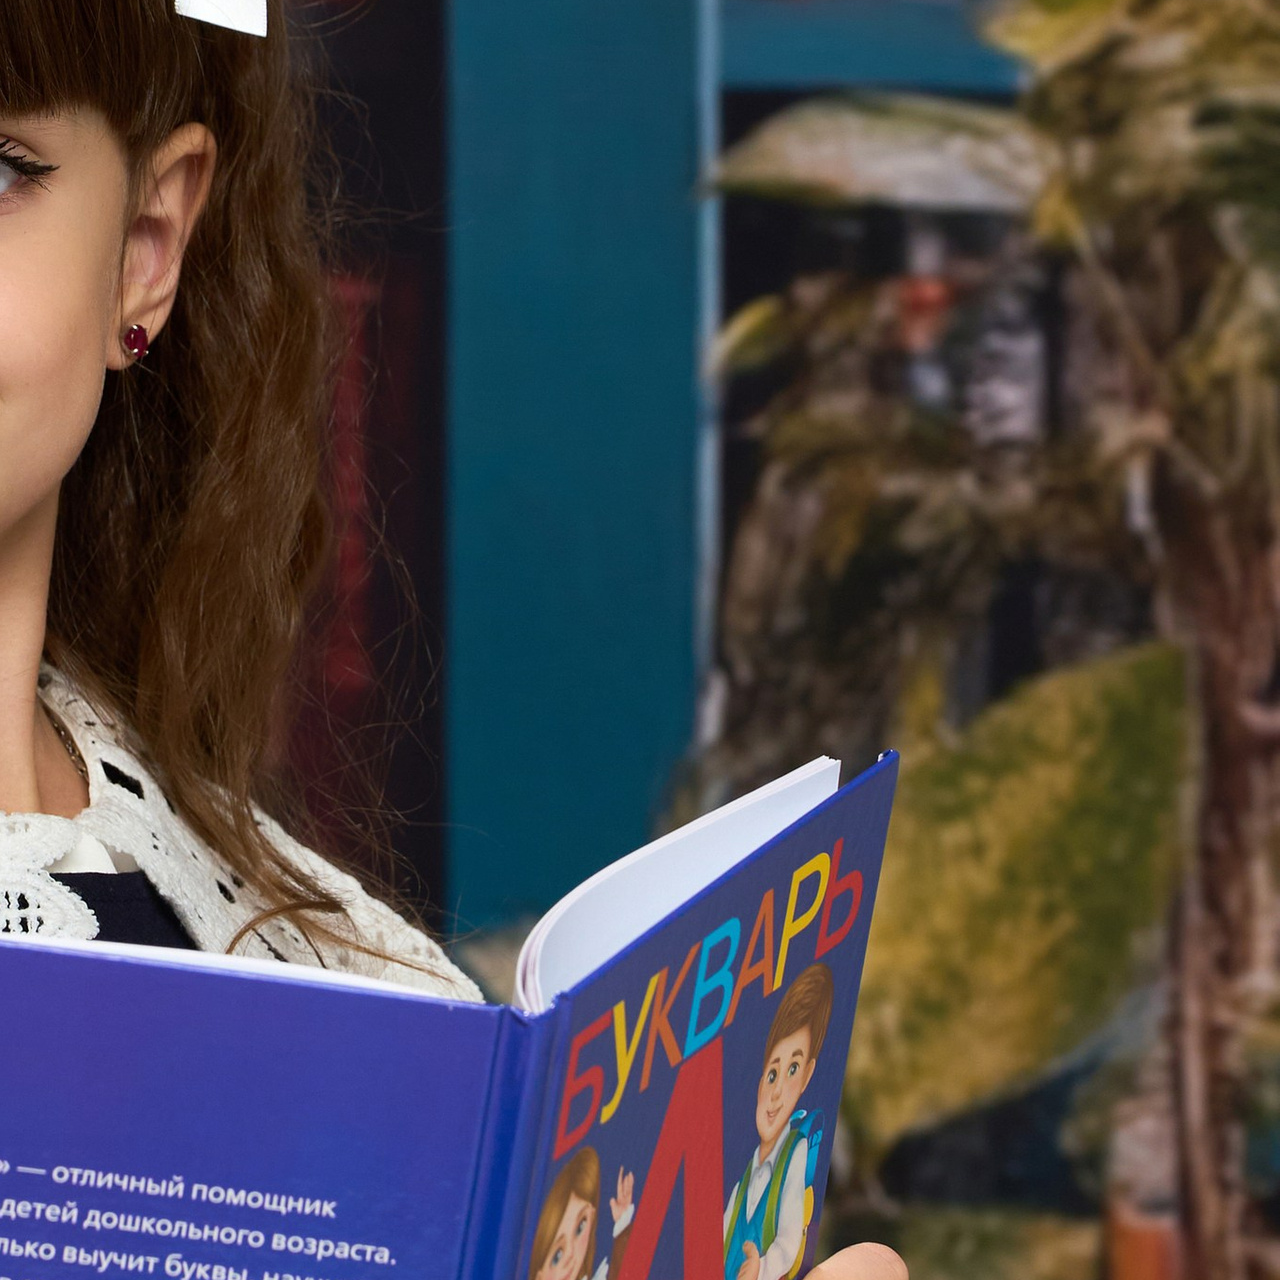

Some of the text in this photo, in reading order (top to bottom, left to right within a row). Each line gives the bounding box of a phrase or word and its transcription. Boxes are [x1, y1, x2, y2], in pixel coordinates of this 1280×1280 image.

[553, 836, 863, 1161] БУКВАРЬ
[51, 1165, 185, 1198] отличный
[191, 1183, 337, 1218] помощник
[62, 1245, 160, 1274] выучит
[82, 1209, 265, 1248] дошкольного
[271, 1233, 396, 1265] возраста.
